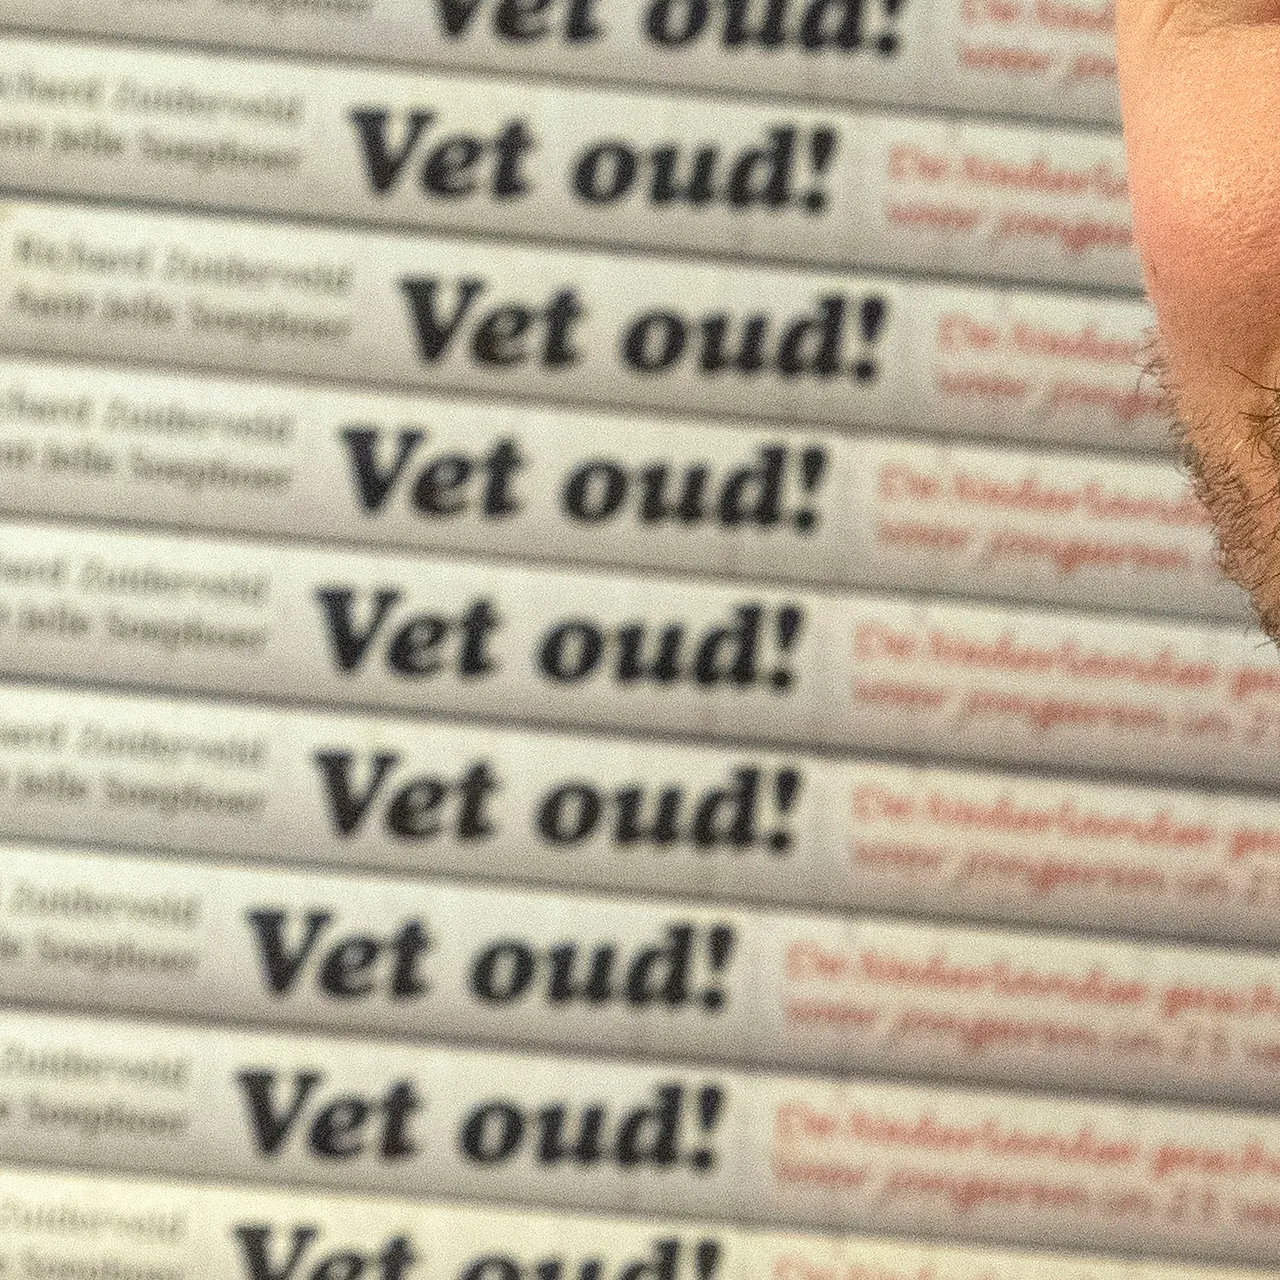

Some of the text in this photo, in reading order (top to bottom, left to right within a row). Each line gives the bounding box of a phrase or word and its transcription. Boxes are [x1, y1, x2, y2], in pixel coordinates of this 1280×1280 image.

[347, 108, 840, 219] Vet oud!
[397, 277, 890, 388] Vet oud!
[338, 426, 831, 537] Vet oud!
[313, 586, 806, 697] Vet oud!
[312, 749, 805, 860] Vet oud!
[245, 907, 738, 1018] Vet oud!
[234, 1068, 727, 1179] Vet oud!
